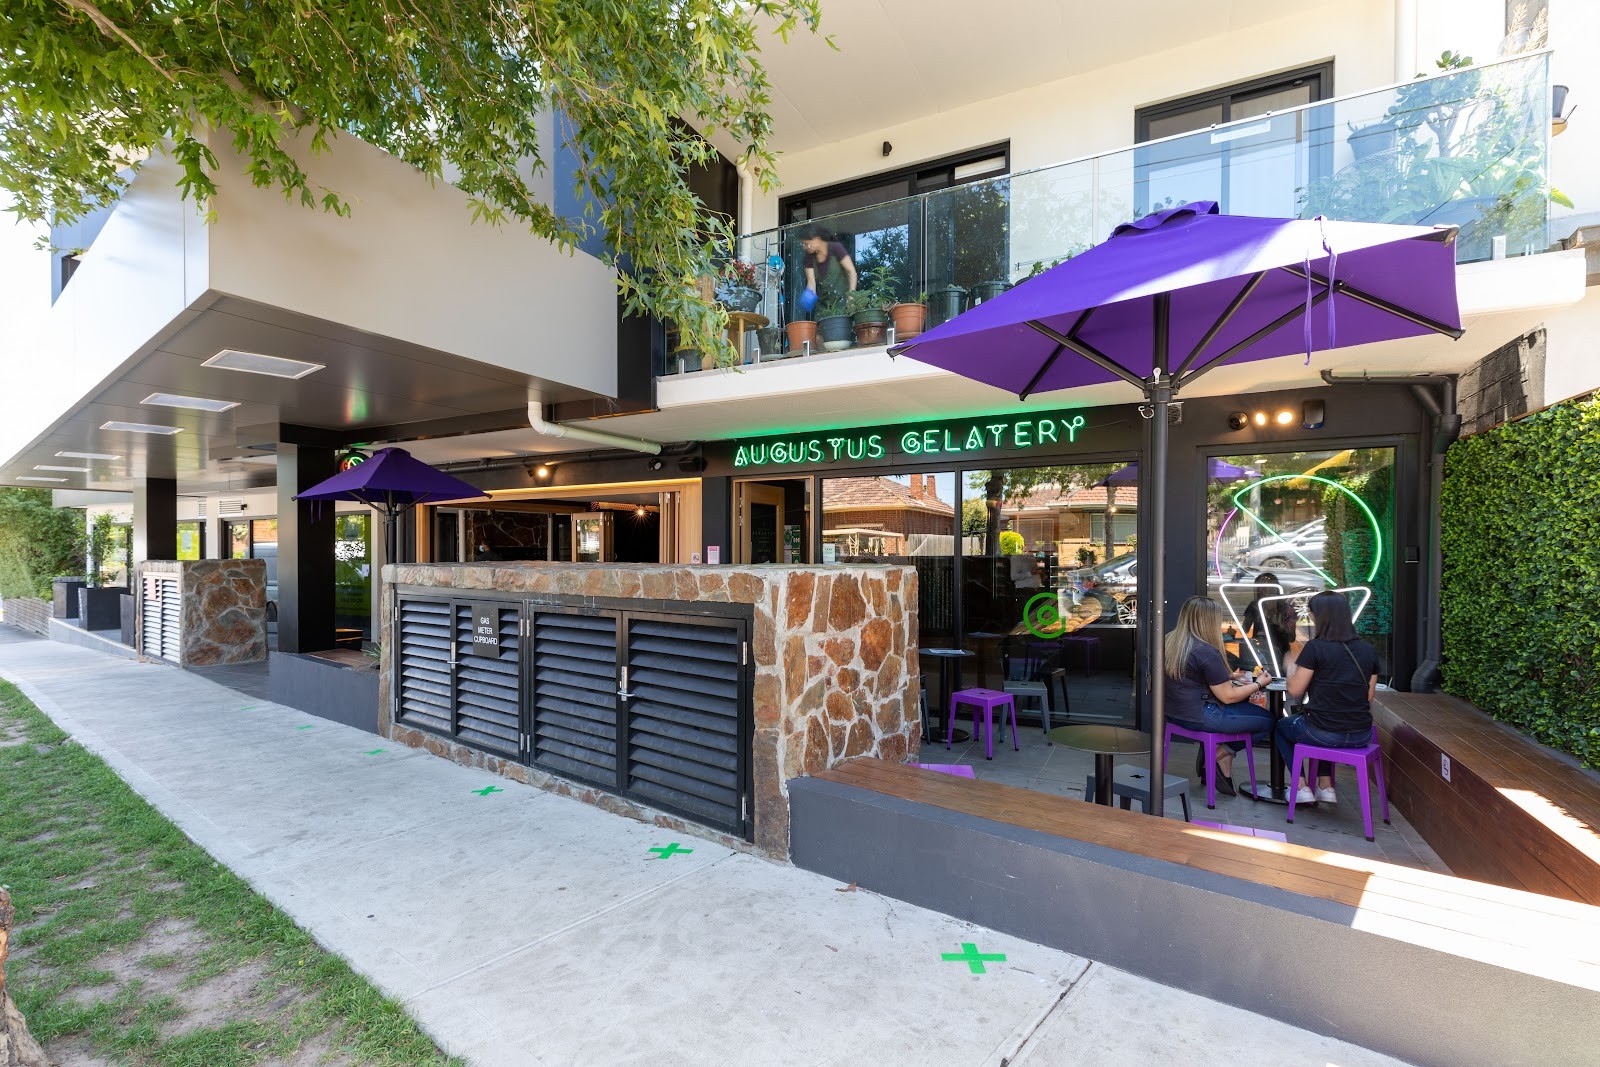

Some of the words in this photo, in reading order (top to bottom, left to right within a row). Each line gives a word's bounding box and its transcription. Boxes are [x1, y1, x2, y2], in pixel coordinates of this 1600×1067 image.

[734, 435, 883, 467] AUGUSTUS
[901, 415, 1085, 453] GELATERY
[477, 626, 493, 634] METER
[473, 635, 498, 645] CUPBOARD
